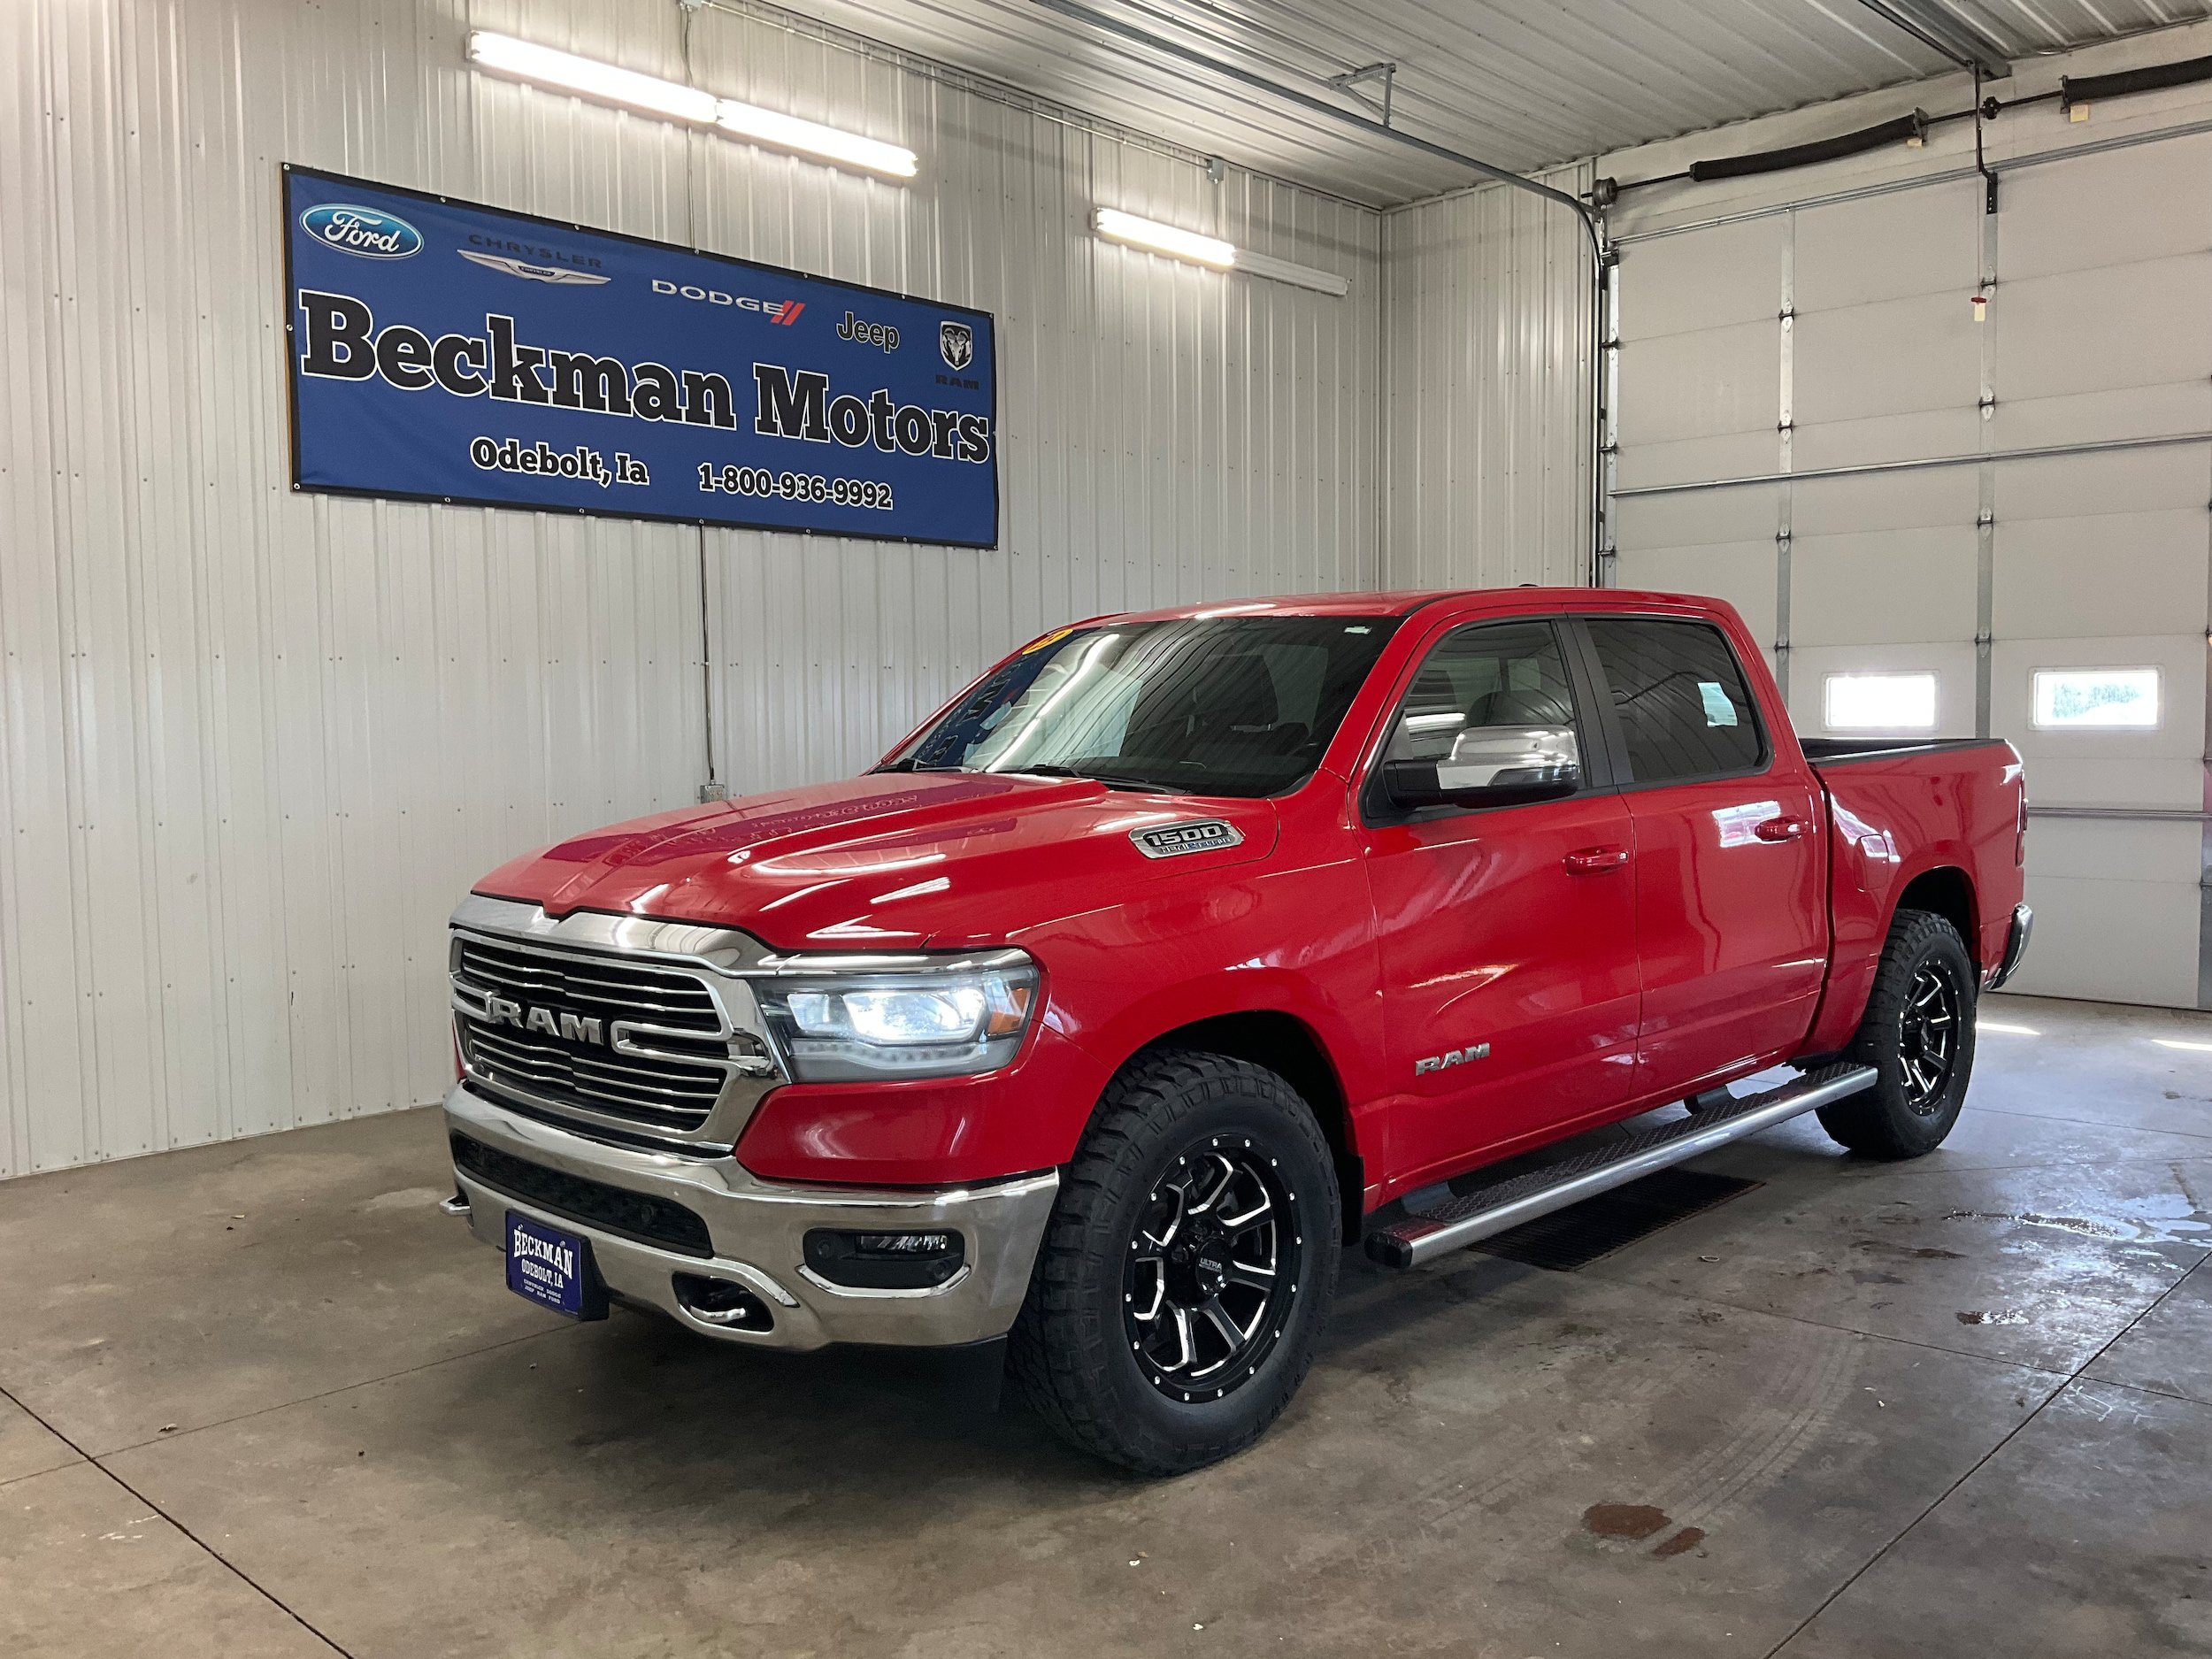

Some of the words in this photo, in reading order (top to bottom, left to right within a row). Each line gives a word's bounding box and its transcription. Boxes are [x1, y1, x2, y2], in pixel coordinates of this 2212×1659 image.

[325, 211, 401, 252] Ford
[469, 234, 602, 268] CHRYSLER
[652, 279, 785, 317] DODGE
[836, 311, 900, 353] Jeep
[298, 288, 737, 432] Beckman
[753, 362, 990, 464] Motors
[935, 374, 979, 390] RAM
[470, 435, 611, 488] Odebolt,
[616, 452, 650, 486] Ia
[697, 462, 894, 511] 1-800-936-9992
[1147, 826, 1223, 846] 1500
[492, 996, 604, 1046] RAM
[1415, 1042, 1490, 1076] RAM
[513, 1229, 572, 1279] BECKMAN
[521, 1258, 554, 1287] ODEBOLT,
[554, 1271, 565, 1289] IA
[1200, 1257, 1222, 1271] ULTRA
